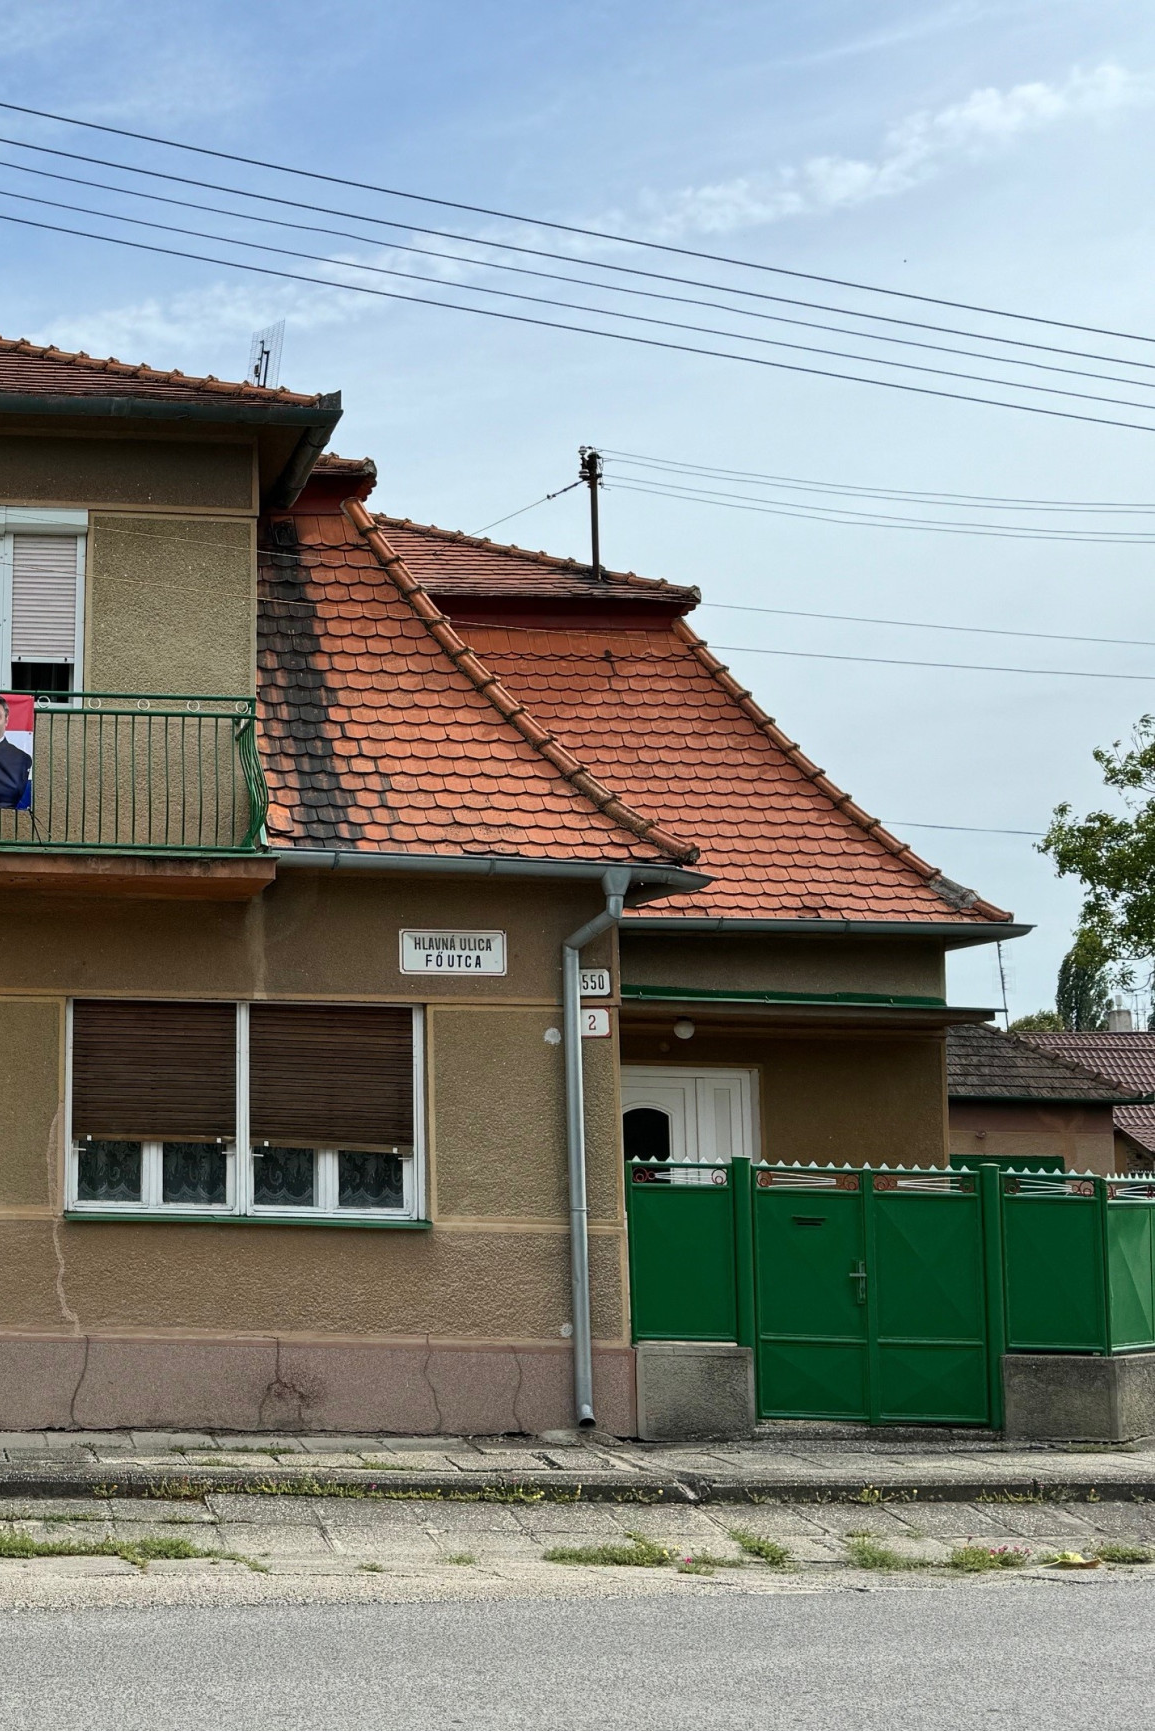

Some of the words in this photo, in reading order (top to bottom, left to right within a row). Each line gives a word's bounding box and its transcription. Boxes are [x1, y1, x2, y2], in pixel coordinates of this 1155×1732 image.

[414, 935, 456, 951] HLAVNÁ
[459, 938, 492, 951] ULICA
[582, 974, 605, 990] 550
[588, 1014, 597, 1030] 2
